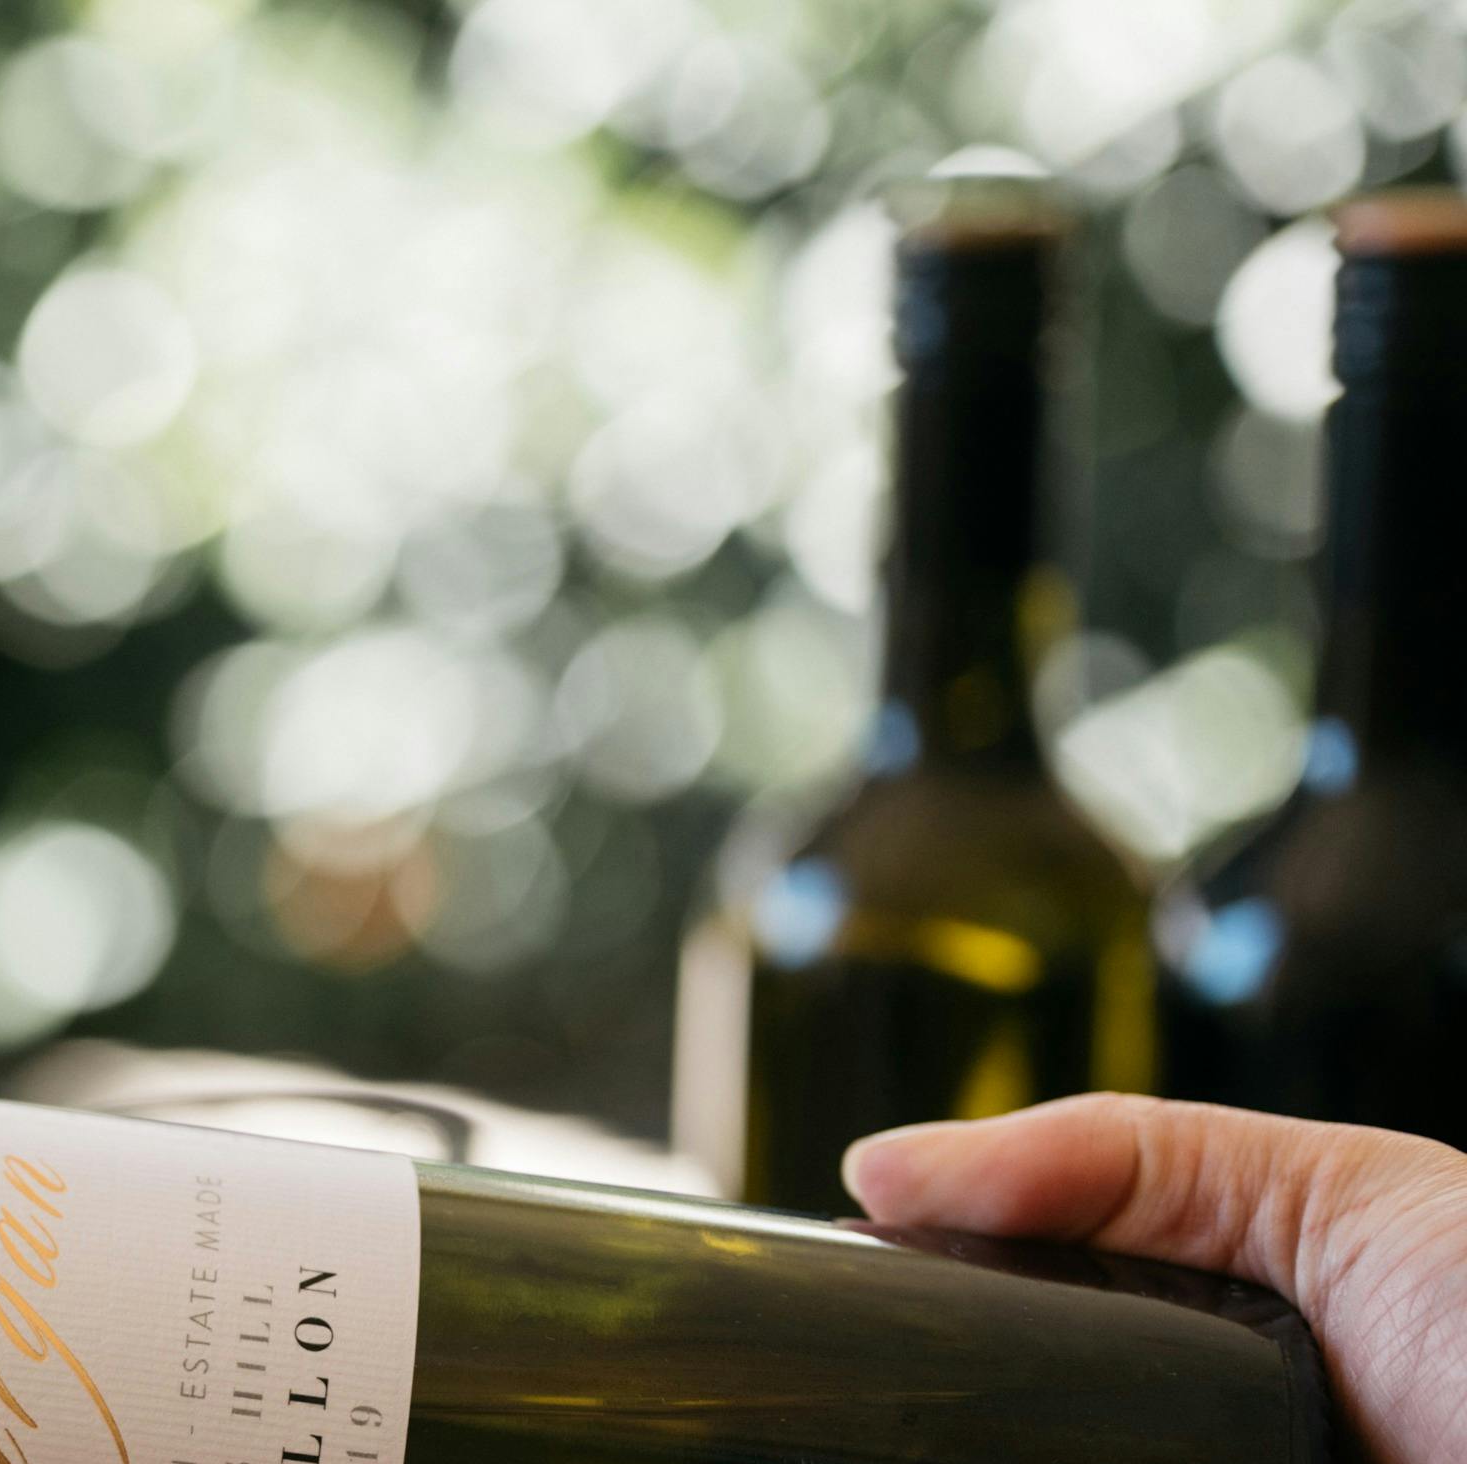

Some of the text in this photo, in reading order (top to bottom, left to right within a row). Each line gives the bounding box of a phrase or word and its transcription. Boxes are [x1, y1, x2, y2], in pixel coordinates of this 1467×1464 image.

[195, 1174, 223, 1251] MADE
[180, 1267, 219, 1400] ESTATE
[231, 1282, 275, 1421] HILL
